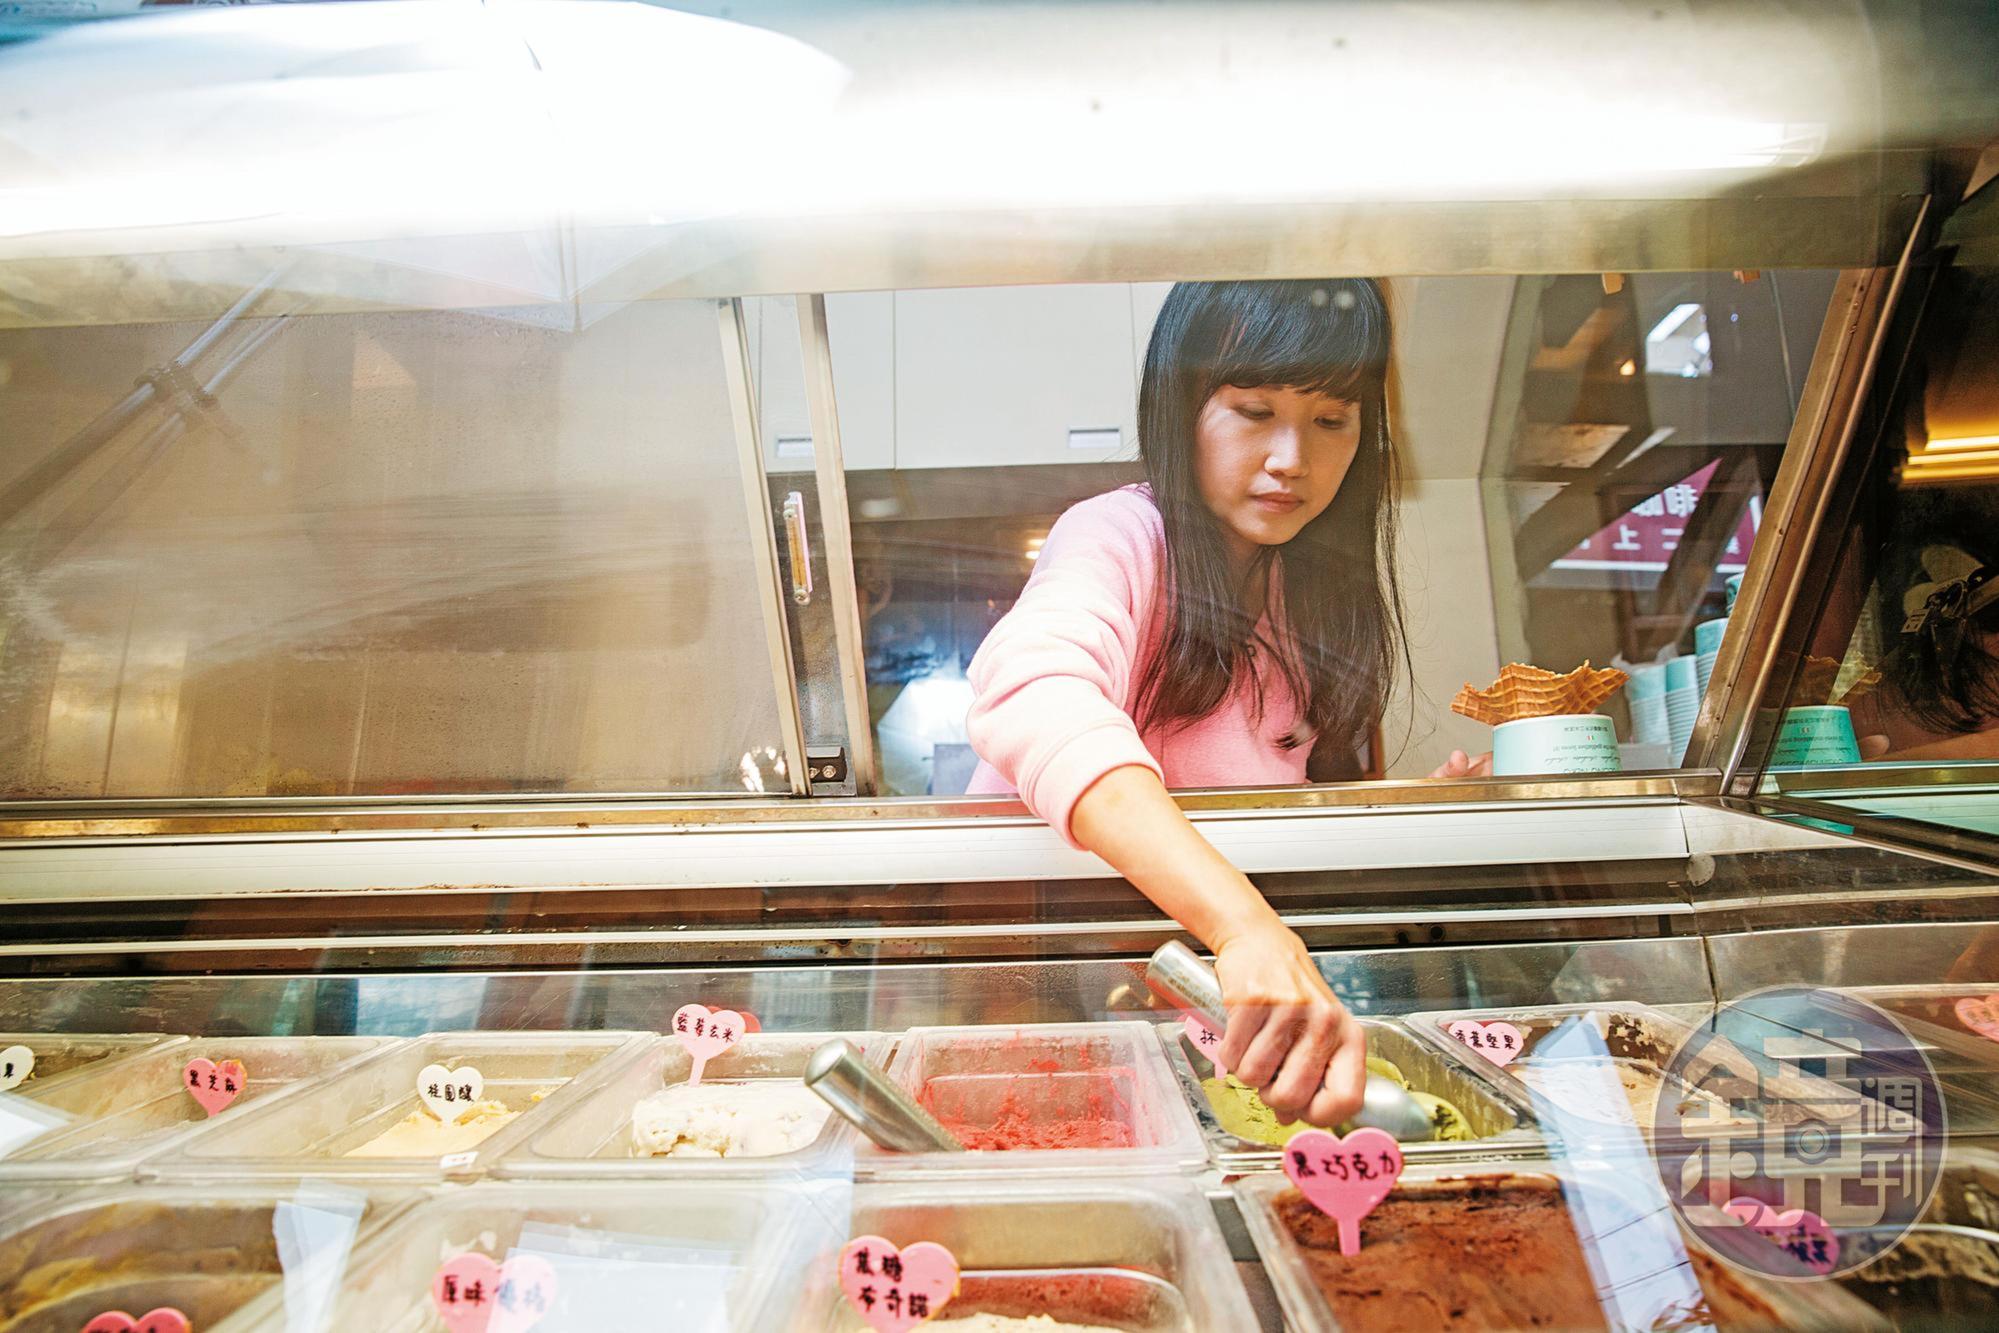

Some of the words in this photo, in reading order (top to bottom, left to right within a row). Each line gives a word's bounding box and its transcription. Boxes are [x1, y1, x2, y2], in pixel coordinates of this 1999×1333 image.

[189, 1069, 237, 1095] 黑芝麻
[1292, 1151, 1396, 1181] 黑巧克力
